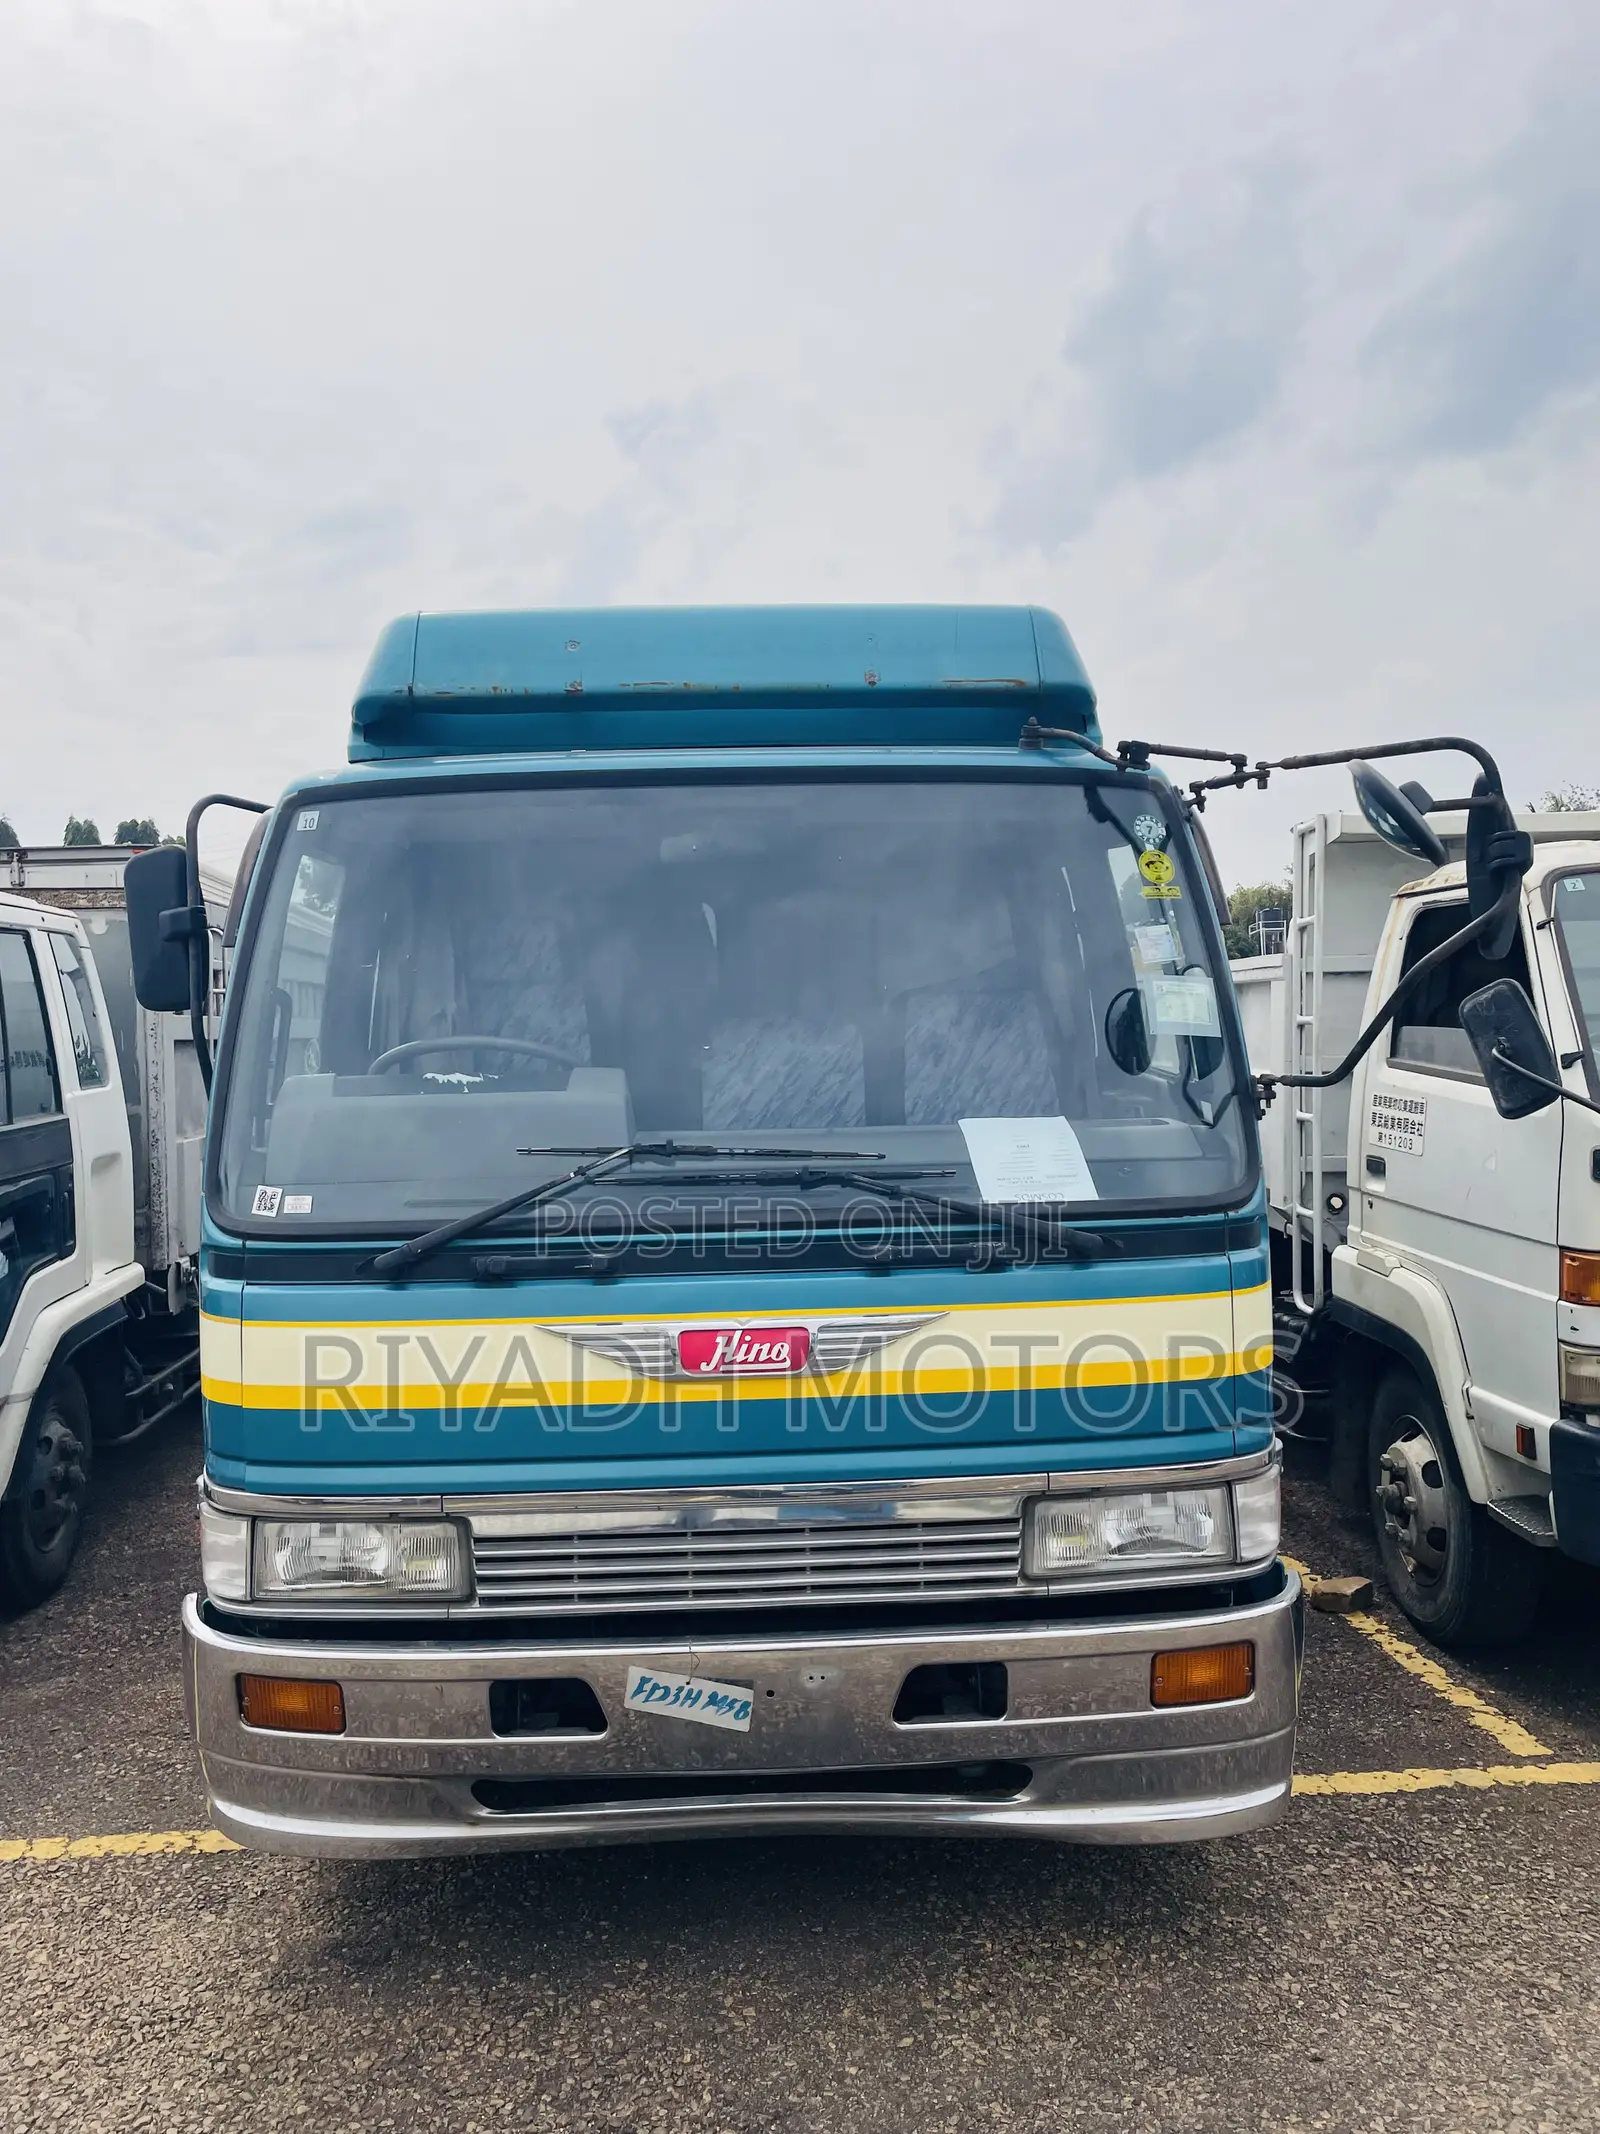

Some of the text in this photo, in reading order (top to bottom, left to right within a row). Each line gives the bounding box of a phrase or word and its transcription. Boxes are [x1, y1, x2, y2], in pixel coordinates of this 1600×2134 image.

[303, 817, 315, 829] 10
[1146, 825, 1153, 835] 7
[1378, 1132, 1413, 1150] 第151203
[700, 1330, 791, 1371] Hino
